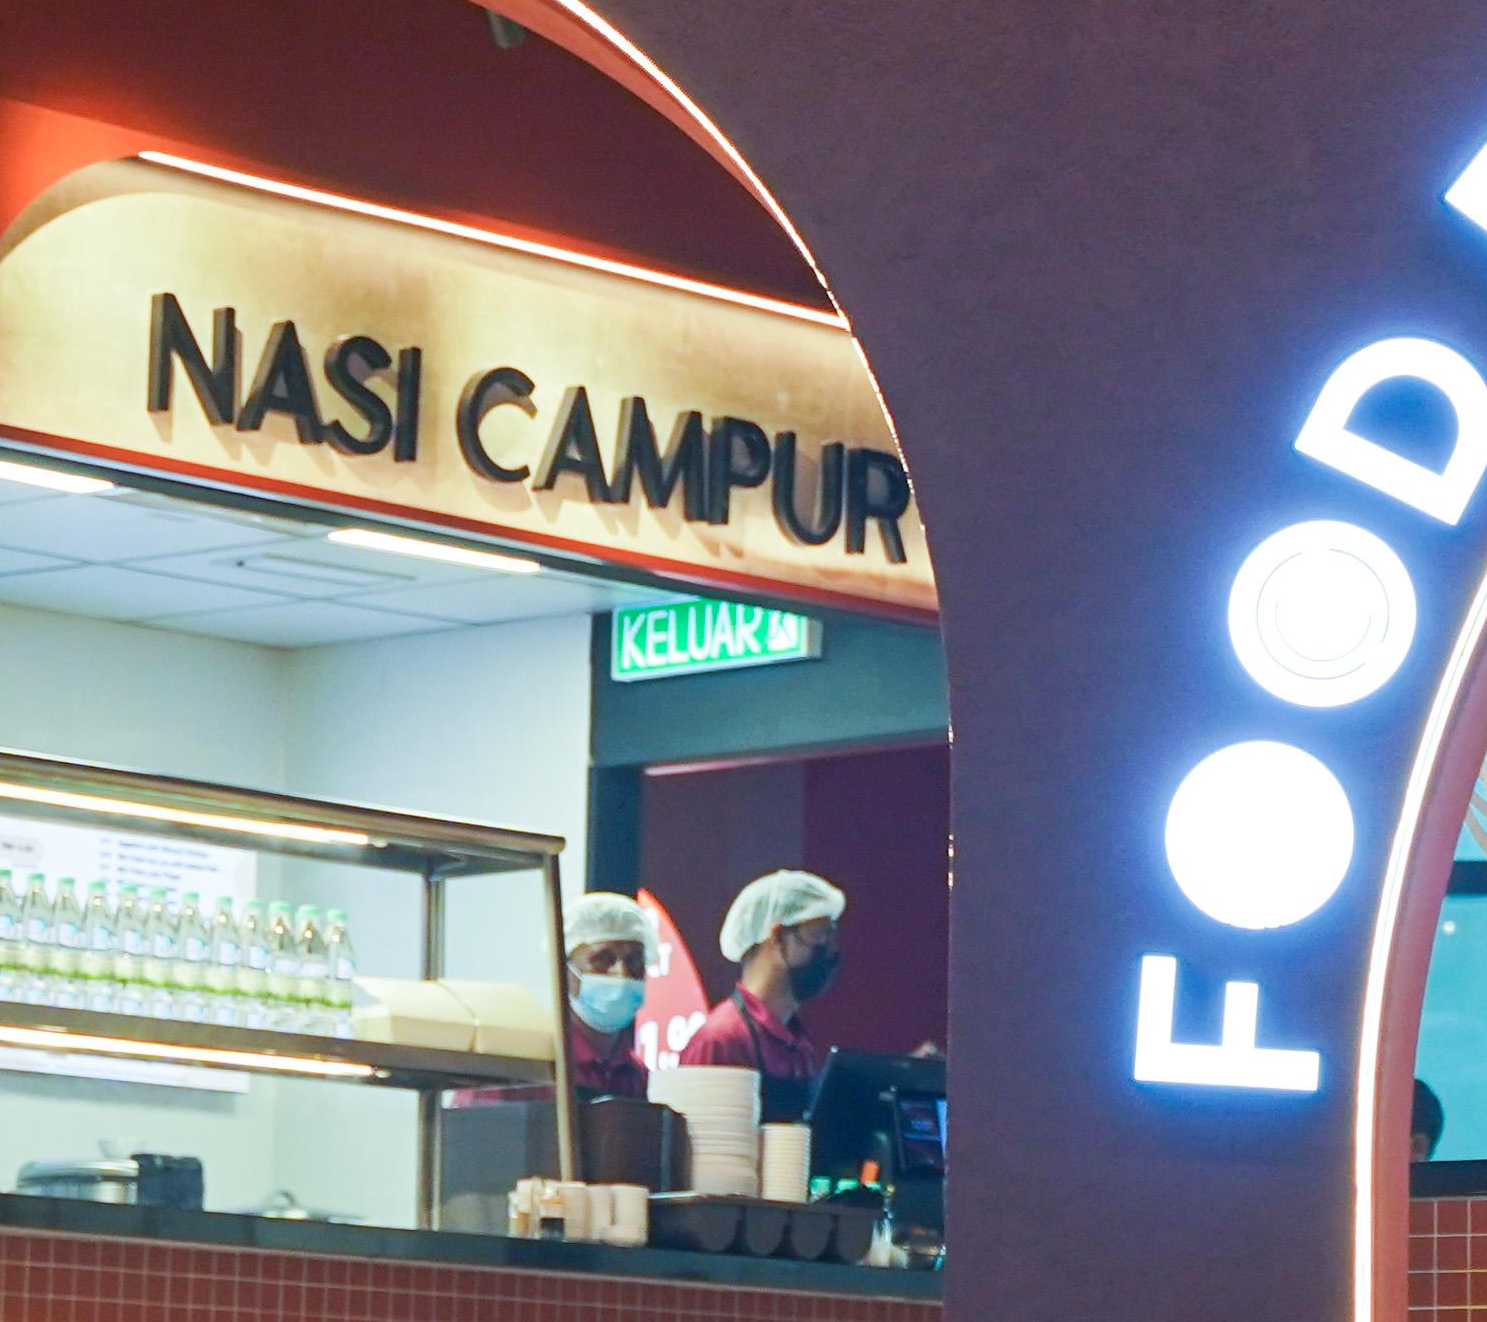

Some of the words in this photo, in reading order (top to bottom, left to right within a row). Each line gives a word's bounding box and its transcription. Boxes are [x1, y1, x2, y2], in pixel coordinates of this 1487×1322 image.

[147, 291, 422, 463] NASI
[456, 366, 911, 564] CAMPUR
[621, 601, 762, 670] KELUAR
